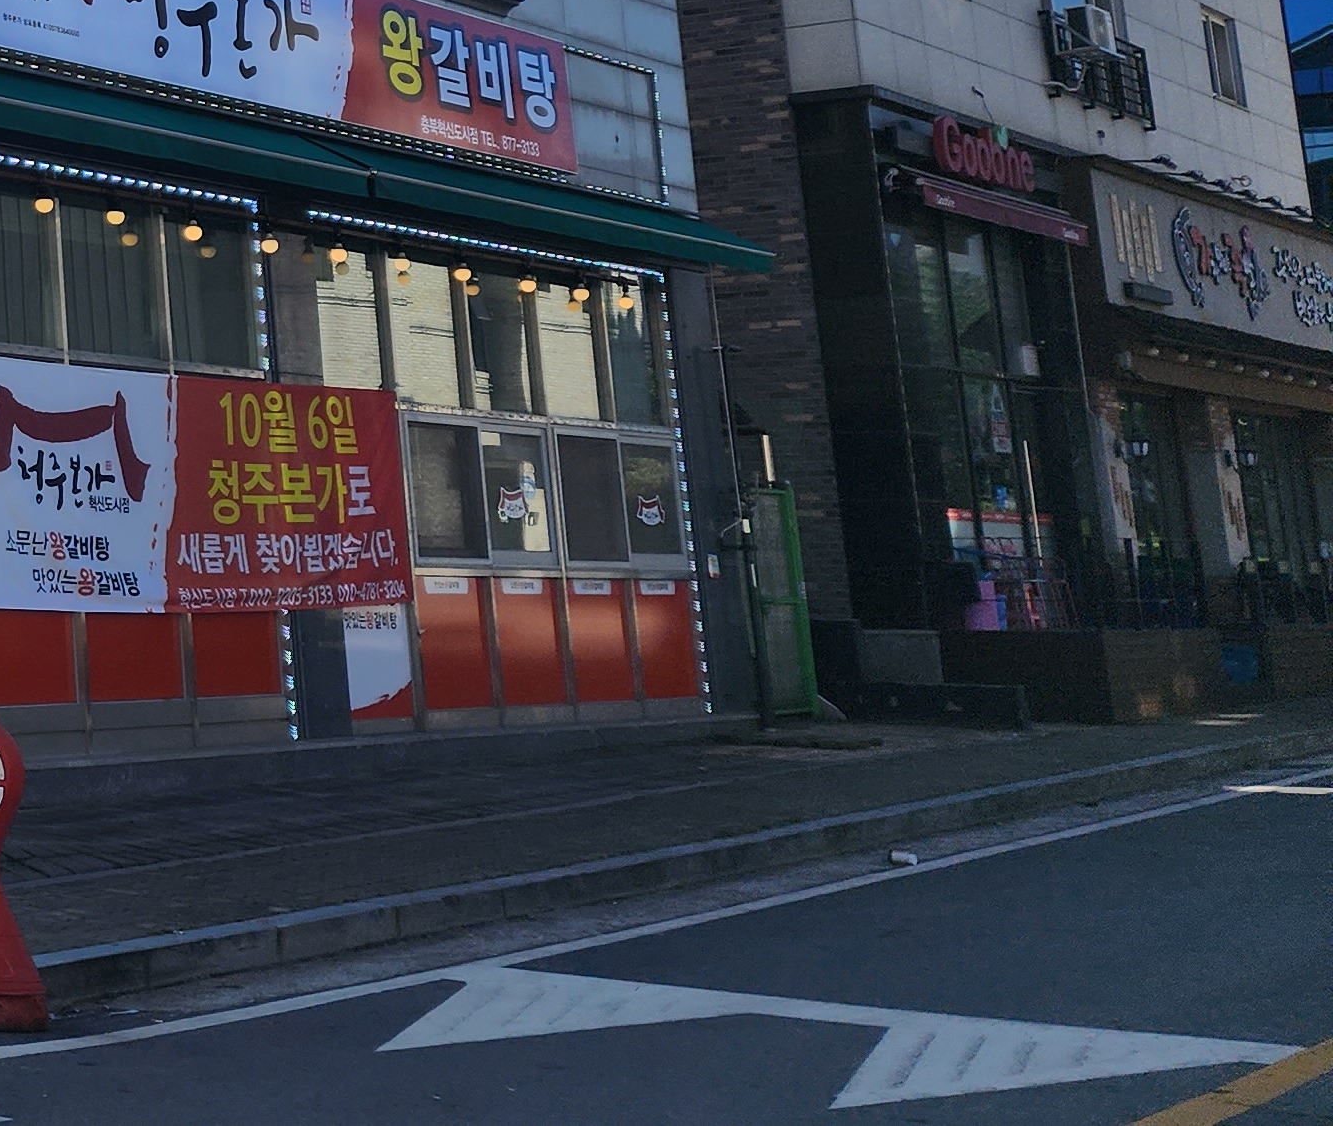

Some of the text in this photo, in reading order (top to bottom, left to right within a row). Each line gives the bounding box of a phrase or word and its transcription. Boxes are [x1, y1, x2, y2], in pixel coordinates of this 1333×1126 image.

[381, 9, 557, 130] 왕갈비탕
[420, 115, 540, 157] 충북혁신도시점 TEL. 877-3133
[934, 115, 1035, 192] Goobne
[219, 390, 360, 454] 10월 6일
[15, 445, 116, 511] 청주본가
[208, 459, 376, 525] 청주본가로
[88, 494, 130, 515] 혁신도시점
[5, 529, 111, 561] 소문난왕갈비탕
[176, 529, 400, 574] 새롭게 찾아뵙겠습니다.
[32, 566, 141, 597] 맛있는왕갈비탕
[179, 588, 237, 610] 혁신도시점
